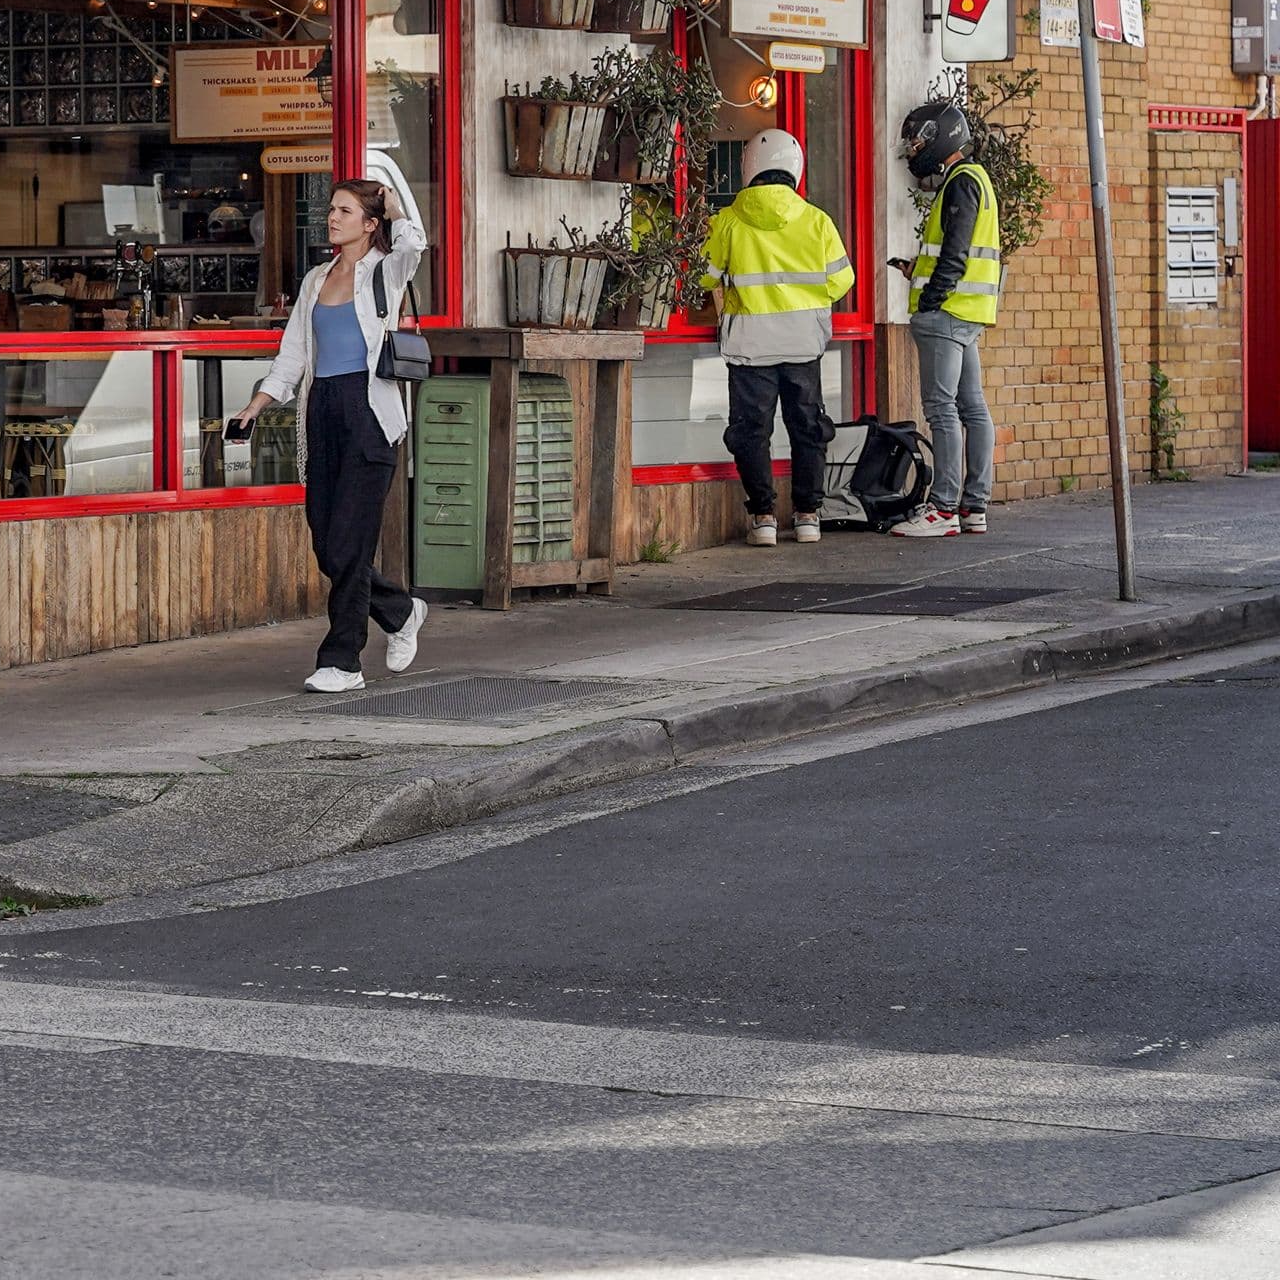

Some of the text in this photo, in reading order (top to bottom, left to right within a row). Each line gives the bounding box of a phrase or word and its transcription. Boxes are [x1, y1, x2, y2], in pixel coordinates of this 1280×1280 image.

[256, 49, 323, 71] MILK
[202, 78, 257, 86] THICKSHAKES
[279, 102, 316, 110] WHIPPED
[267, 155, 330, 164] LOTUS BISCOFF
